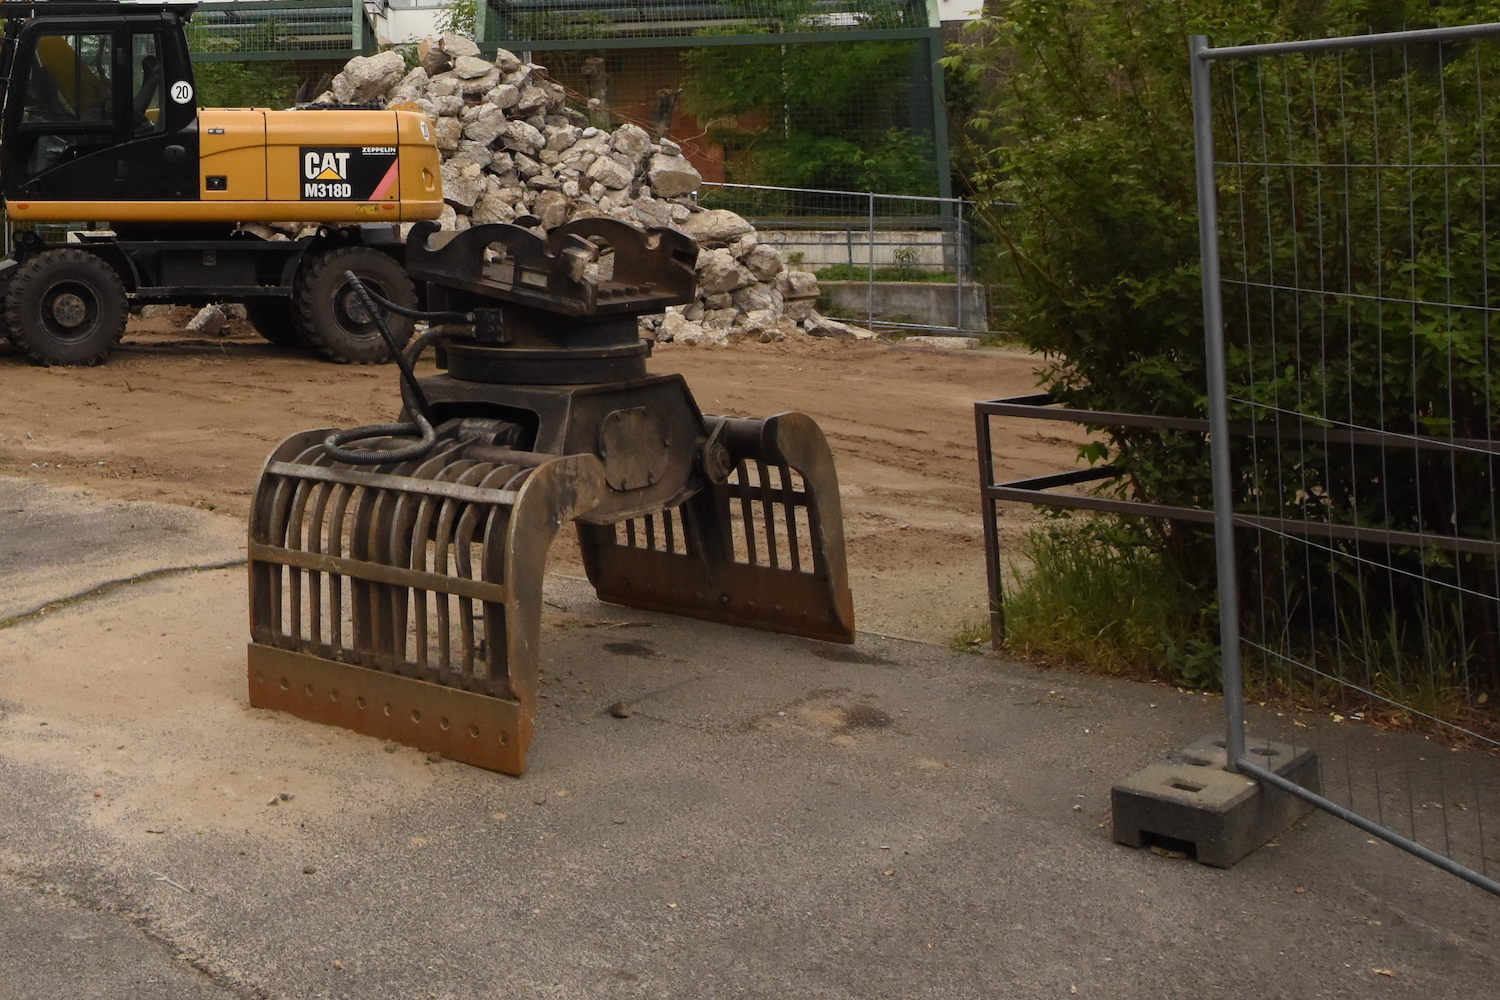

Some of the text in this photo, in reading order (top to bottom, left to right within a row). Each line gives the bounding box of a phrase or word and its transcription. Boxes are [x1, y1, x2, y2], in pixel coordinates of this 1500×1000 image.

[175, 85, 189, 99] 20
[304, 152, 350, 180] CAT
[304, 183, 352, 198] M318D
